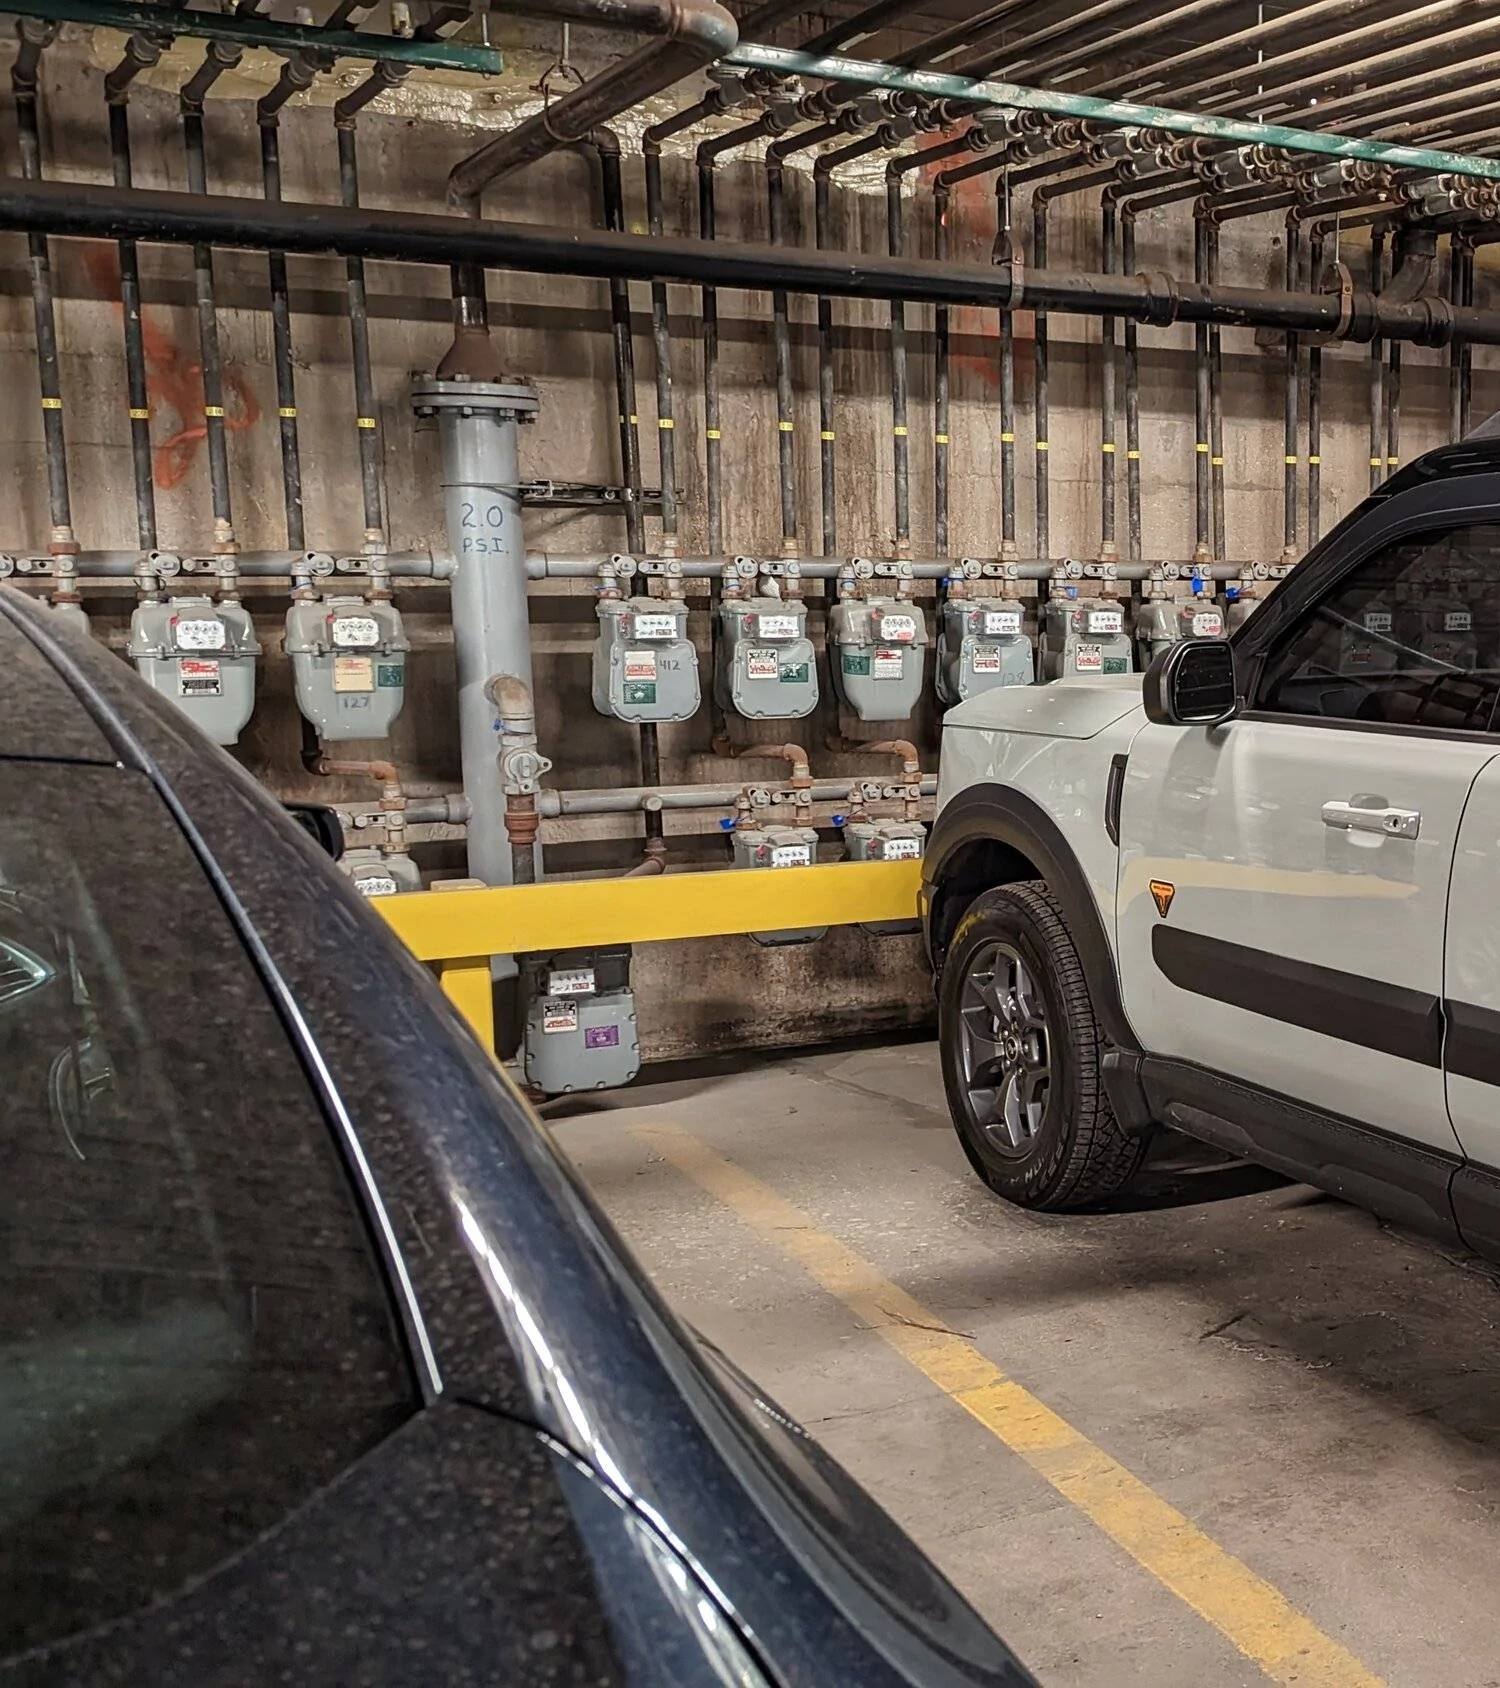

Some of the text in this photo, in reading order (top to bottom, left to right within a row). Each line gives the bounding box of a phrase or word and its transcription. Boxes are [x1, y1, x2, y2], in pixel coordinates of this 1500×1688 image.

[461, 502, 503, 528] 2.0
[660, 660, 681, 671] 412
[343, 696, 370, 709] 127
